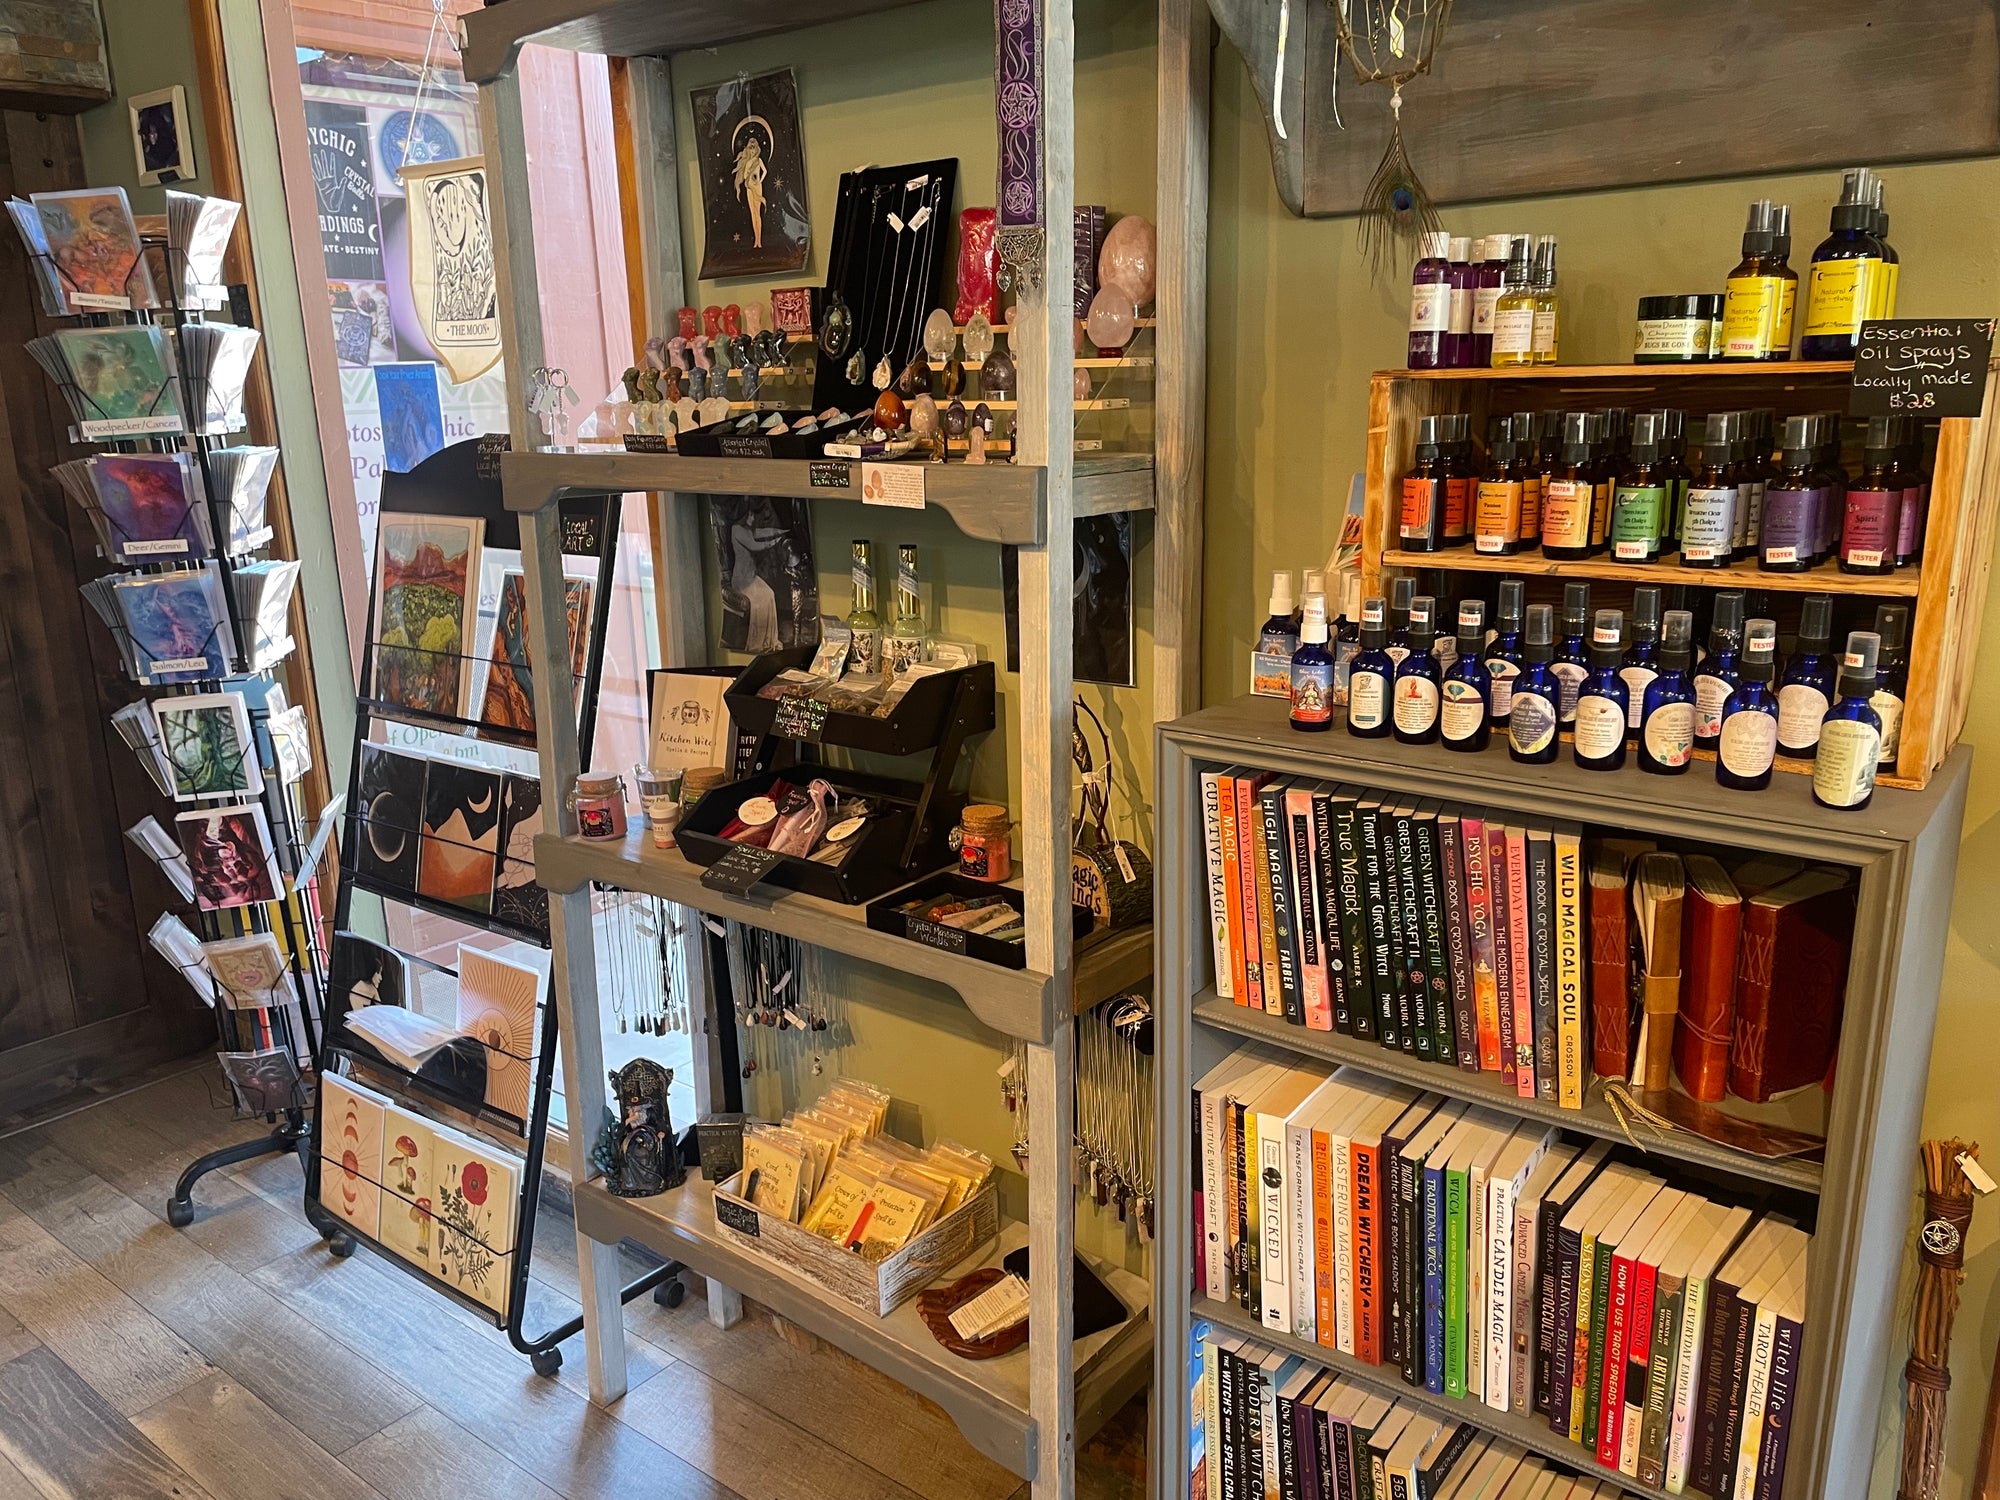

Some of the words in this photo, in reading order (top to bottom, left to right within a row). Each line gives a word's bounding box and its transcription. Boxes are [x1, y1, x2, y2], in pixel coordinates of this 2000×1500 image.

[308, 127, 356, 156] YCHIC
[344, 166, 375, 198] CRYSTAL
[323, 246, 340, 254] ATE
[345, 246, 379, 256] DESTINY
[450, 319, 466, 335] THE
[466, 318, 489, 336] MOON
[1863, 324, 1961, 340] Essential
[1860, 346, 1890, 360] Oil
[1900, 345, 1971, 366] Sprays
[1853, 376, 1912, 394] Locally
[1922, 370, 1974, 385] made
[1890, 392, 1936, 409] $28
[85, 418, 180, 434] Woodpecker/Cancer
[445, 415, 475, 437] hic
[128, 542, 182, 552] Deer/Gemini
[566, 521, 590, 535] LOCAL
[566, 536, 584, 552] ART
[1594, 631, 1617, 640] TESTER
[152, 660, 204, 671] Salmon/Leo
[660, 733, 691, 744] Kitchen
[1222, 786, 1231, 812] TEA
[1239, 787, 1250, 846] EVERYDAY
[1207, 782, 1222, 866] CURATIVE
[1223, 816, 1235, 861] MAGIC
[1263, 800, 1278, 840] HIGH
[1317, 801, 1332, 861] MYTHOLOGY
[1337, 811, 1354, 851] True
[1444, 829, 1454, 846] THE
[1384, 836, 1395, 872] GREEN
[1397, 820, 1412, 863] GREEN
[1418, 827, 1433, 872] GREEN
[1073, 864, 1099, 892] agic
[1258, 844, 1268, 884] Healing
[1269, 849, 1285, 913] MAGICK
[1469, 837, 1483, 896] PSYCHIC
[1510, 846, 1523, 913] EVERYDAY
[1536, 859, 1546, 876] THE
[1561, 854, 1575, 898] WILD
[1073, 885, 1102, 915] nds
[1212, 873, 1225, 923] MAGIC
[1243, 850, 1254, 924] WITCHCRAFT
[1261, 887, 1269, 919] Power
[1341, 858, 1361, 916] Magick
[1401, 865, 1420, 944] WITCHCRAFT
[1448, 880, 1458, 908] BOOK
[1536, 880, 1547, 910] BOOK
[907, 918, 932, 934] Crystal
[1325, 888, 1337, 929] MAGICAL
[1388, 875, 1401, 943] WITCHCRAFT
[1423, 874, 1442, 952] WITCHCRAFT
[1473, 901, 1486, 939] YOGA
[1264, 932, 1273, 949] Tea
[1330, 932, 1340, 951] LIFE
[1451, 926, 1464, 967] CRYSTAL
[1496, 926, 1506, 945] THE
[1536, 929, 1548, 971] CRYSTAL
[1562, 905, 1575, 977] MAGICAL
[1280, 950, 1293, 990] FARBER
[1352, 945, 1361, 976] AMBER
[1497, 948, 1509, 988] MODERN
[1514, 917, 1527, 1001] WITCHCRAFT
[1335, 977, 1344, 1003] GRANT
[1454, 970, 1466, 1000] SPELLS
[1538, 972, 1550, 1006] SPELLS
[1563, 983, 1576, 1025] SOUL
[1499, 992, 1512, 1048] ENNEAGRAM
[1566, 1035, 1574, 1077] CROSSON
[1206, 1103, 1215, 1155] INTUITIVE
[1207, 1159, 1216, 1227] WITCHCRAFT
[1295, 1134, 1303, 1220] TRANSFORMATIVE
[1336, 1144, 1349, 1226] MASTERING
[1357, 1152, 1371, 1210] DREAM
[1401, 1164, 1413, 1201] PAGANISM
[1450, 1178, 1460, 1215] WICCA
[1239, 1180, 1248, 1225] MAGIC
[1426, 1179, 1437, 1243] TRADITIONAL
[1267, 1194, 1280, 1259] WICKED
[1518, 1215, 1532, 1259] ADVANCED
[1297, 1222, 1305, 1282] WITCHCRAFT
[1338, 1231, 1351, 1284] MAGICK
[1359, 1217, 1372, 1296] WITCHERY
[1427, 1246, 1436, 1276] WICCA
[1494, 1238, 1510, 1297] CANDLE
[1581, 1242, 1593, 1284] SEASON
[1517, 1262, 1531, 1294] CANDLE
[1558, 1260, 1572, 1318] WALKING
[1617, 1265, 1626, 1290] HOW
[1688, 1283, 1699, 1303] THE
[1341, 1300, 1349, 1330] AURYN
[1578, 1287, 1590, 1324] SONGS
[1614, 1308, 1623, 1327] USE
[1616, 1293, 1625, 1306] TO
[1634, 1278, 1650, 1349] UNCROSSING
[1493, 1299, 1509, 1343] MAGIC
[1682, 1307, 1696, 1360] EVERYDAY
[1428, 1334, 1437, 1367] MOONEY
[1556, 1328, 1568, 1378] BEAUTY
[1611, 1330, 1622, 1362] TAROT
[1733, 1306, 1749, 1381] EMPOWERMENT
[1755, 1323, 1771, 1369] TAROT
[1775, 1329, 1792, 1375] witch
[1515, 1357, 1526, 1394] BUCKLAND
[1608, 1363, 1619, 1406] SPREADS
[1652, 1355, 1668, 1383] EARTH
[1677, 1364, 1690, 1406] EMPATH
[1222, 1370, 1232, 1415] WITCH'S
[1248, 1370, 1260, 1440] MODERN
[1281, 1400, 1291, 1422] HOW
[1649, 1385, 1664, 1415] MAGIC
[1748, 1369, 1763, 1417] HEALER
[1770, 1381, 1788, 1411] life
[1283, 1440, 1293, 1476] BECOME
[1393, 1477, 1405, 1498] 365
